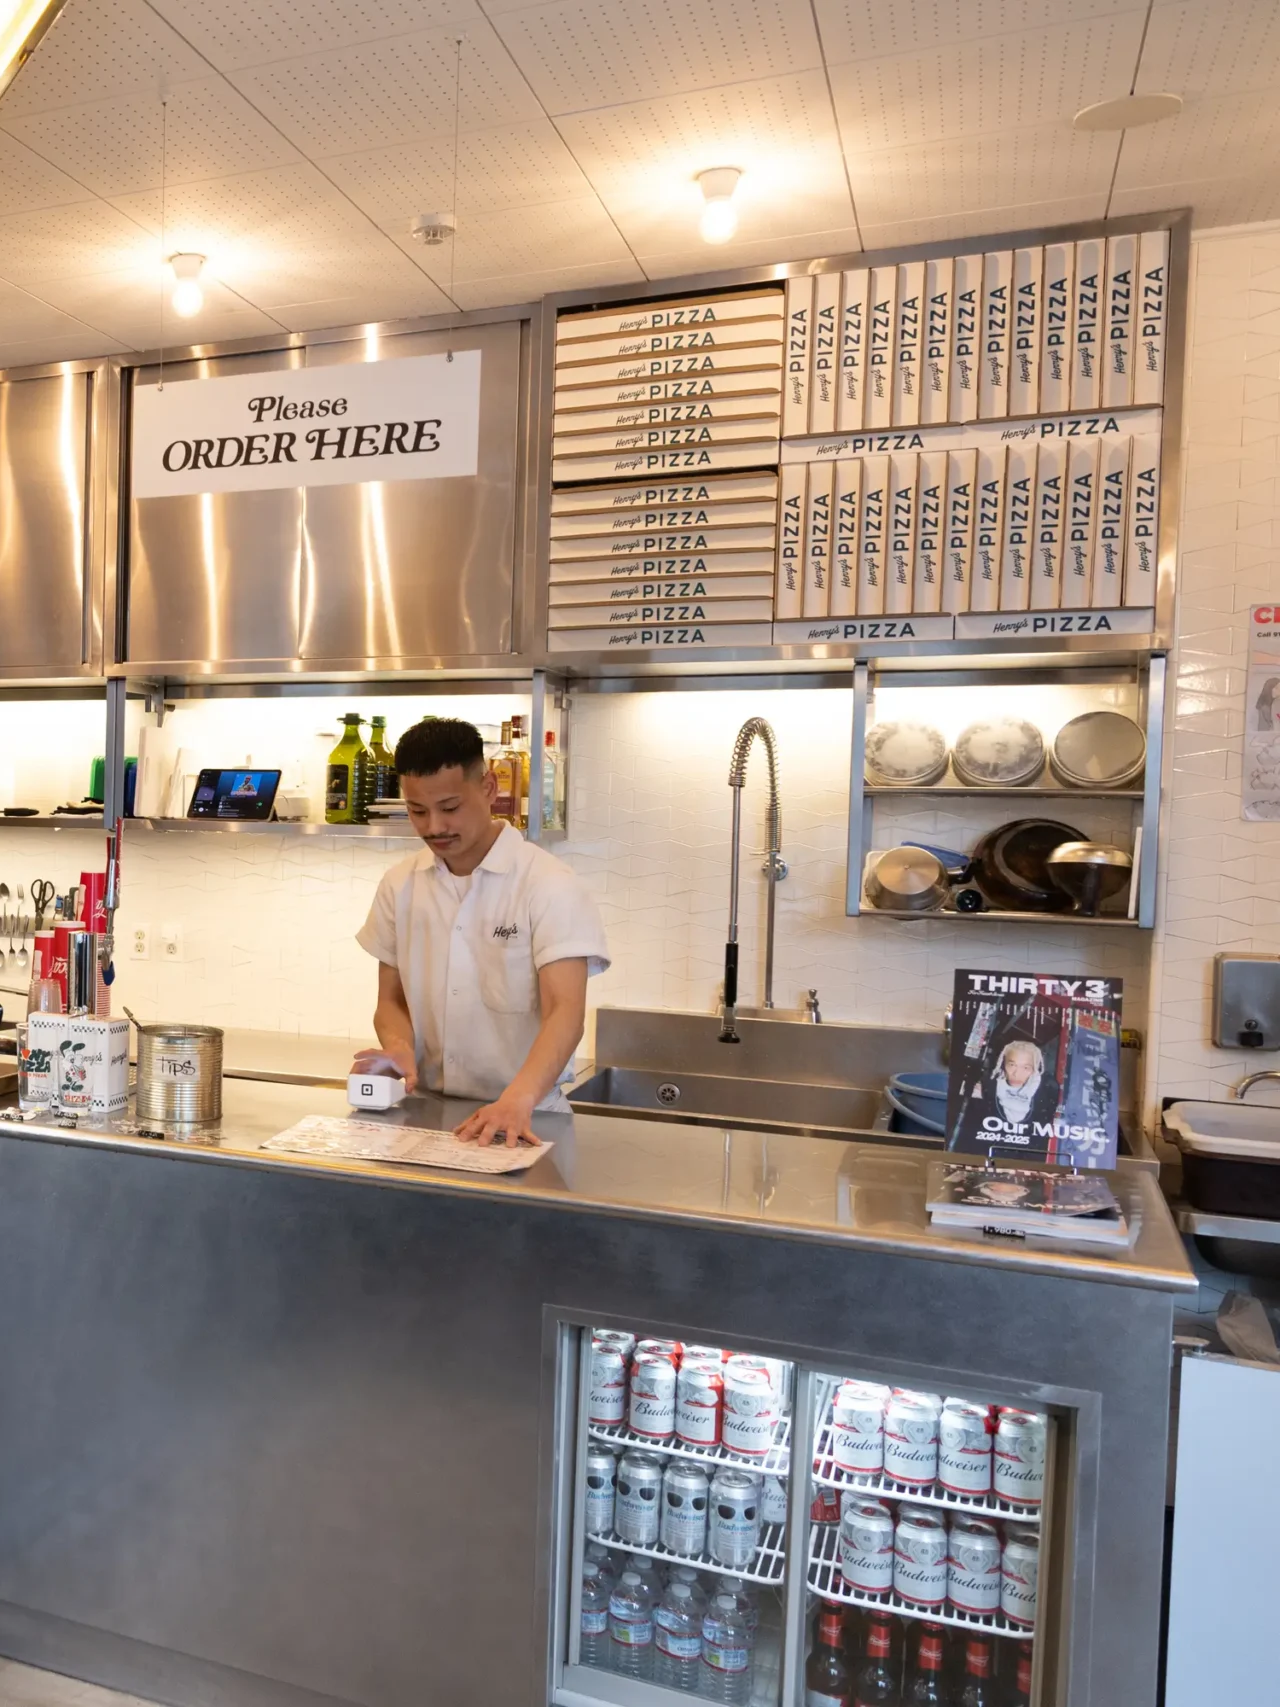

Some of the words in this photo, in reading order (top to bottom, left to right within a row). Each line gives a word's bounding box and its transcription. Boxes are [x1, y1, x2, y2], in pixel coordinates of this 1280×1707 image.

[1017, 282, 1037, 349] PIZZA
[1048, 278, 1068, 346] PIZZA
[1078, 275, 1098, 343] PIZZA
[1110, 270, 1131, 340] PIZZA
[1143, 267, 1164, 337] PIZZA
[619, 317, 648, 330] Henry's
[653, 309, 716, 327] PIZZA
[872, 301, 890, 365] PIZZA
[900, 297, 919, 363] PIZZA
[928, 293, 948, 359] PIZZA
[957, 290, 976, 356] PIZZA
[987, 286, 1007, 353] PIZZA
[619, 340, 647, 353] Henry's
[652, 333, 715, 351] PIZZA
[790, 309, 808, 372] PIZZA
[816, 306, 834, 370] PIZZA
[843, 303, 862, 367] PIZZA
[618, 364, 646, 377] Henry's
[651, 357, 714, 375] PIZZA
[1017, 354, 1032, 383] Henry's
[1049, 351, 1062, 380] Henry's
[1079, 348, 1093, 378] Henry's
[1111, 344, 1125, 374] Henry's
[1143, 342, 1158, 371] Henry's
[844, 372, 858, 400] Henry's
[872, 369, 885, 397] Henry's
[900, 367, 914, 394] Henry's
[929, 363, 942, 392] Henry's
[957, 361, 971, 389] Henry's
[988, 357, 1002, 387] Henry's
[617, 388, 646, 400] Henry's
[650, 381, 713, 398] PIZZA
[791, 377, 803, 404] Henry's
[818, 374, 831, 402] Henry's
[248, 396, 348, 423] Please
[616, 411, 645, 424] Henry's
[649, 405, 712, 422] PIZZA
[615, 434, 644, 446] Henry's
[649, 428, 712, 445] PIZZA
[1001, 426, 1036, 440] Henry's
[1041, 417, 1120, 438] PIZZA
[162, 431, 298, 472] ORDER
[305, 419, 442, 461] HERE
[817, 441, 849, 454] Henry's
[853, 433, 924, 452] PIZZA
[615, 458, 643, 470] Henry's
[648, 451, 711, 468] PIZZA
[614, 492, 641, 504] Henry's
[646, 486, 709, 503] PIZZA
[1041, 476, 1061, 543] PIZZA
[1071, 474, 1093, 541] PIZZA
[1102, 471, 1124, 539] PIZZA
[1135, 468, 1156, 537] PIZZA
[613, 516, 640, 527] Henry's
[646, 510, 708, 526] PIZZA
[812, 494, 830, 557] PIZZA
[838, 492, 856, 555] PIZZA
[865, 490, 883, 553] PIZZA
[893, 488, 912, 551] PIZZA
[921, 486, 940, 550] PIZZA
[950, 483, 970, 548] PIZZA
[979, 480, 1000, 546] PIZZA
[1009, 478, 1031, 545] PIZZA
[783, 496, 801, 559] PIZZA
[613, 540, 639, 551] Henry's
[645, 535, 707, 551] PIZZA
[1136, 542, 1151, 572] Henry's
[612, 563, 638, 574] Henry's
[644, 559, 706, 574] PIZZA
[866, 558, 879, 587] Henry's
[894, 556, 907, 584] Henry's
[922, 555, 935, 584] Henry's
[952, 553, 965, 582] Henry's
[980, 551, 994, 580] Henry's
[1011, 550, 1025, 579] Henry's
[1042, 548, 1055, 578] Henry's
[1072, 546, 1086, 576] Henry's
[1102, 544, 1117, 574] Henry's
[784, 563, 797, 591] Henry's
[813, 561, 826, 589] Henry's
[839, 560, 852, 588] Henry's
[611, 586, 638, 597] Henry's
[644, 582, 706, 597] PIZZA
[611, 610, 637, 620] Henry's
[643, 606, 705, 621] PIZZA
[993, 619, 1028, 633] Henry's
[1033, 616, 1112, 632] PIZZA
[610, 632, 637, 643] Henry's
[642, 629, 704, 644] PIZZA
[808, 625, 840, 639] Henry's
[844, 622, 915, 639] PIZZA
[982, 1116, 1029, 1135] Our
